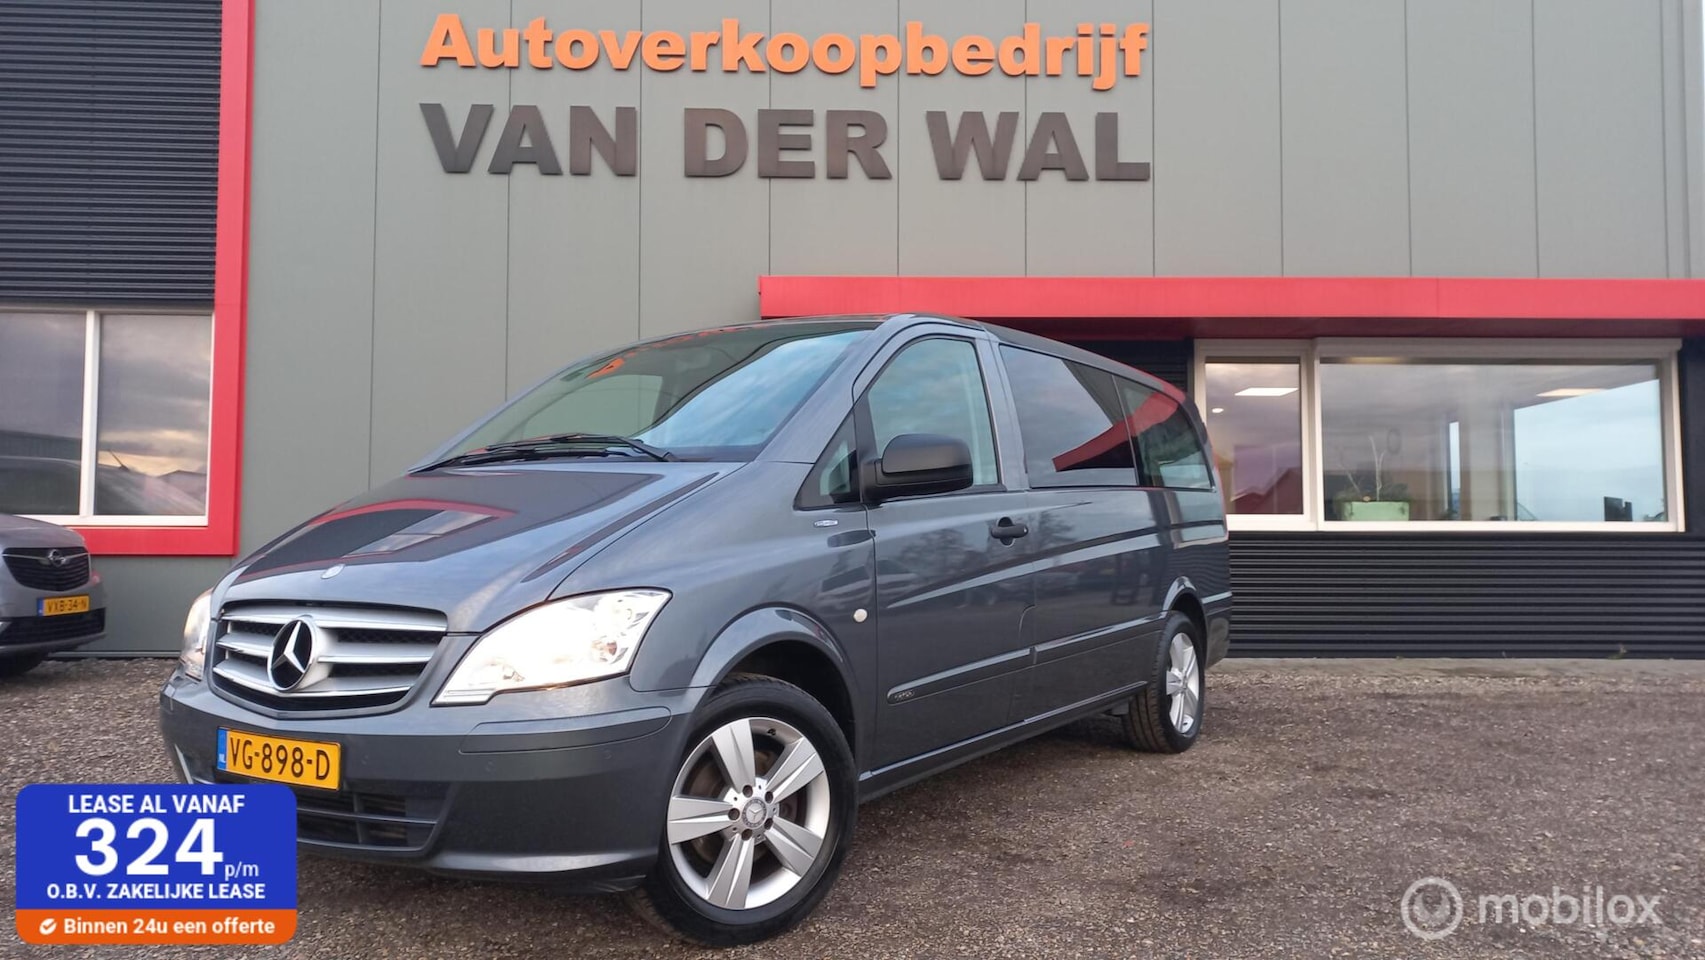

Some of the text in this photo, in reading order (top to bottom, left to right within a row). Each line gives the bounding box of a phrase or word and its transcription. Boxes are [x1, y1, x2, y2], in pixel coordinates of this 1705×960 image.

[421, 13, 1149, 90] Autoverkoopbedrijf
[420, 103, 1151, 182] VAN DER WAL
[230, 737, 330, 780] VG-898-D
